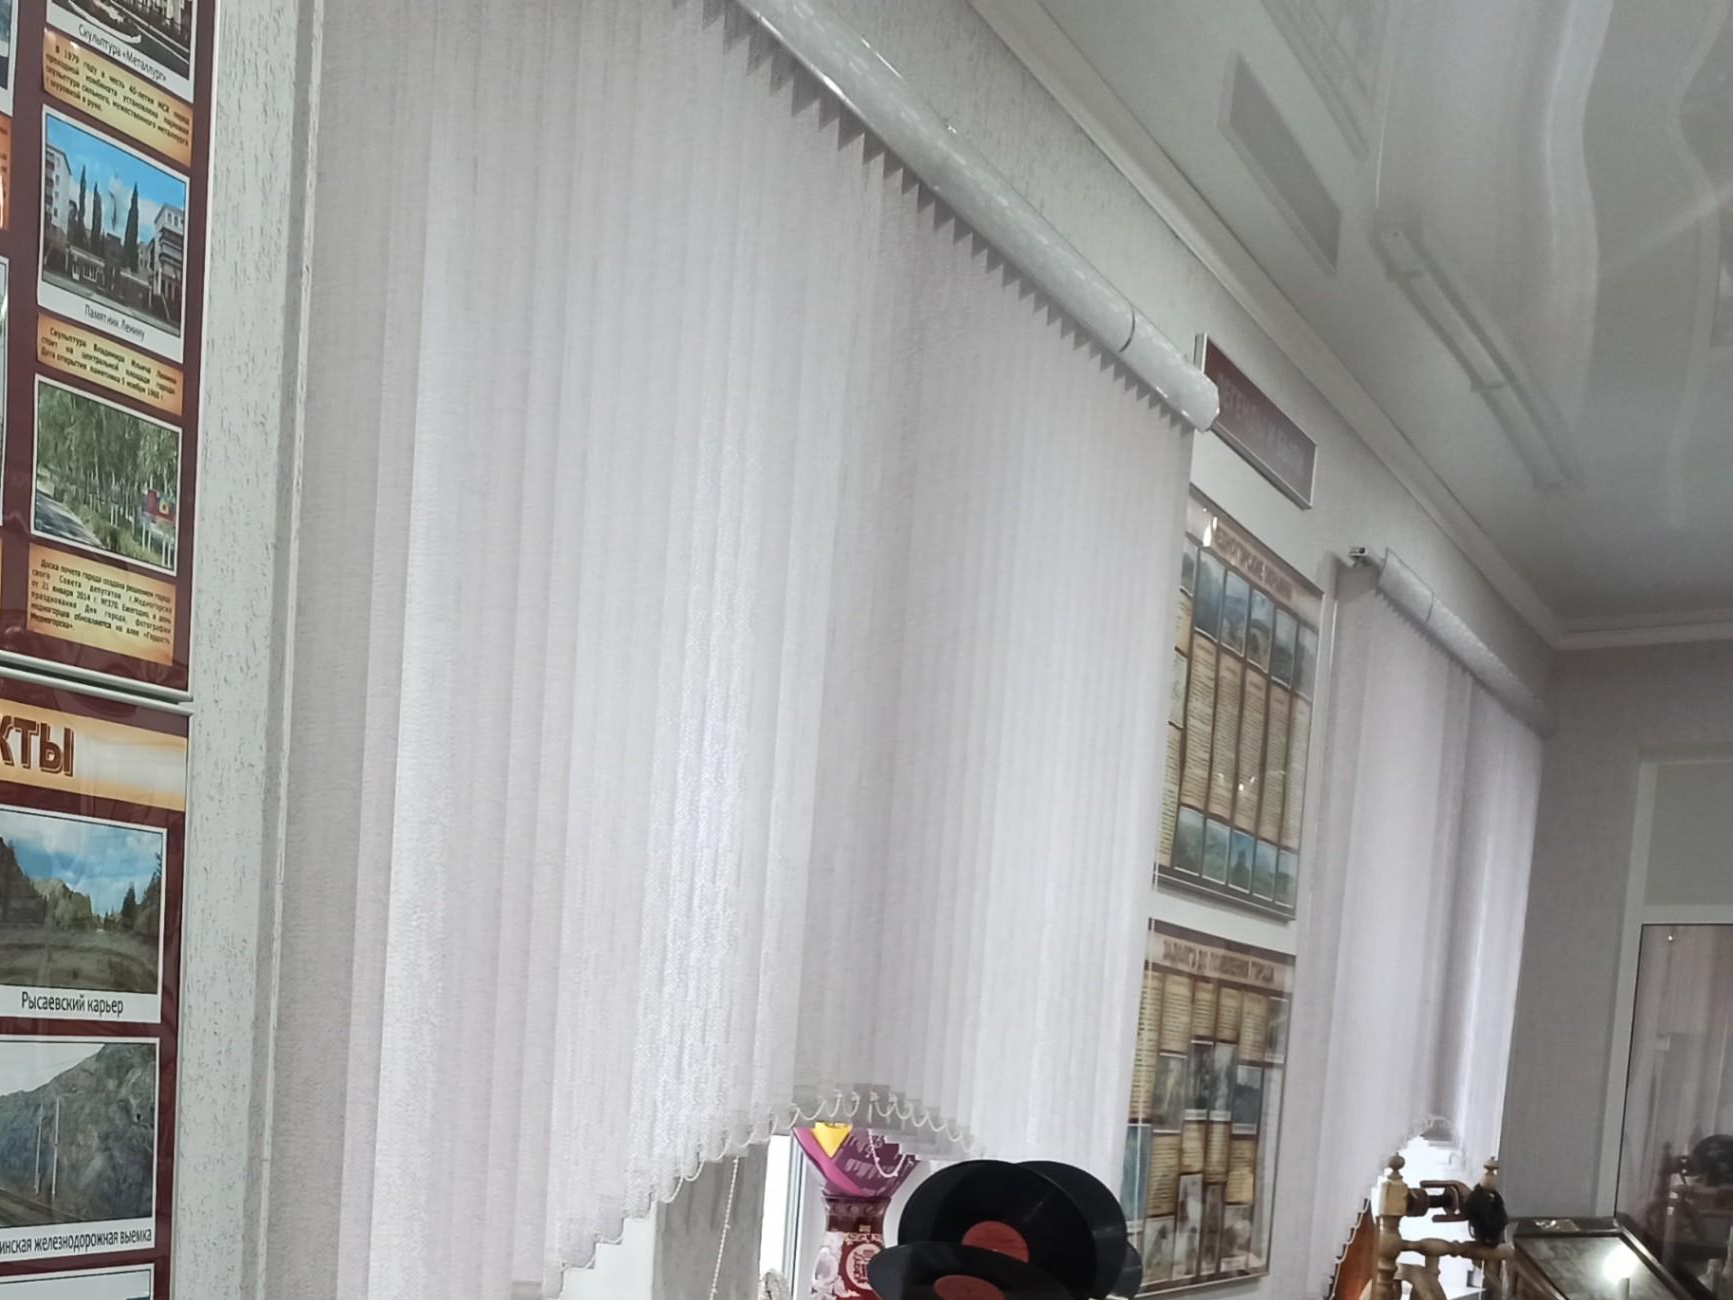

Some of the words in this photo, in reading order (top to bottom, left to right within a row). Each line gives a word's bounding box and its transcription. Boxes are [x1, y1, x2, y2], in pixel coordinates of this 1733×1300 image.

[21, 990, 85, 1011] Рысаевский
[86, 999, 124, 1018] карьер
[33, 1231, 118, 1254] железнодорожная
[119, 1228, 153, 1246] выемка
